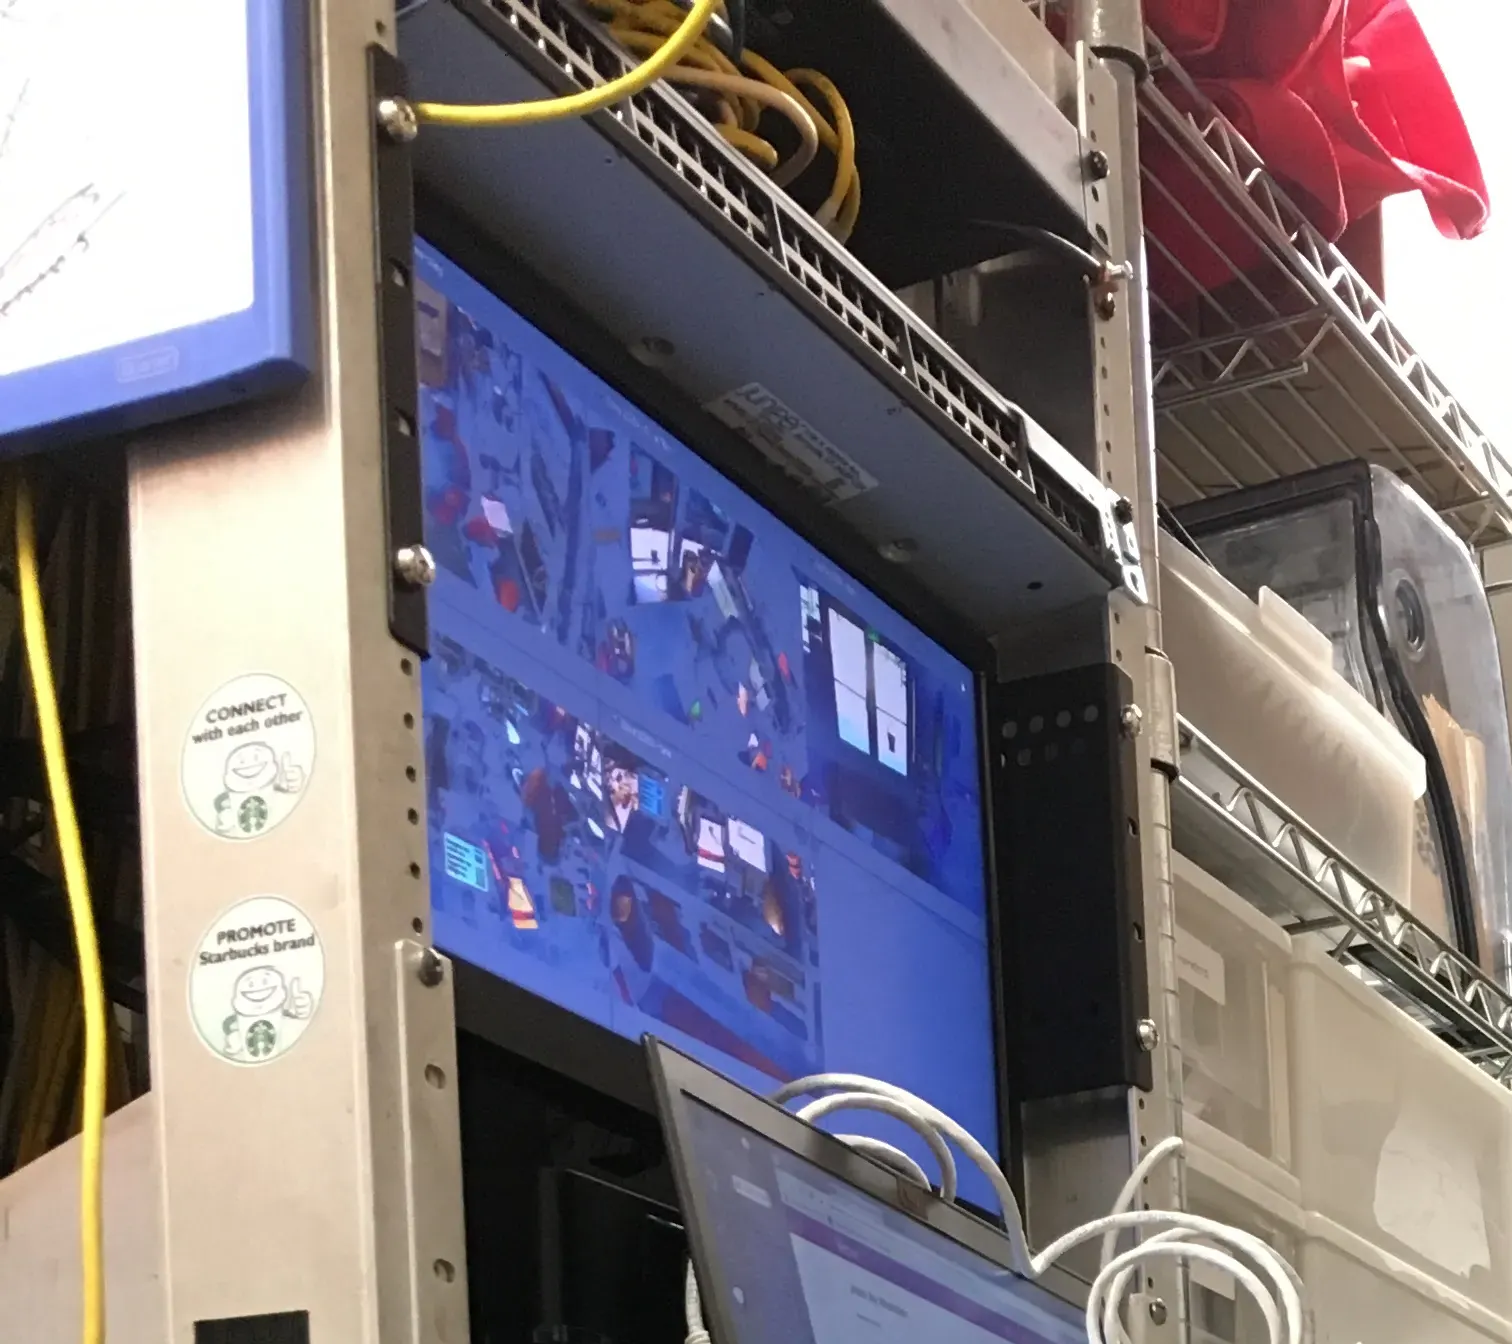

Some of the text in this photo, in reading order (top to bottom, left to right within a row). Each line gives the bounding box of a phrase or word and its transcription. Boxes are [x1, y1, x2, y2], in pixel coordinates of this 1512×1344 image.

[205, 693, 287, 724] CONNECT
[192, 711, 303, 744] with each other
[217, 918, 296, 945] PROMOTE
[199, 932, 316, 966] Starbucks brand
